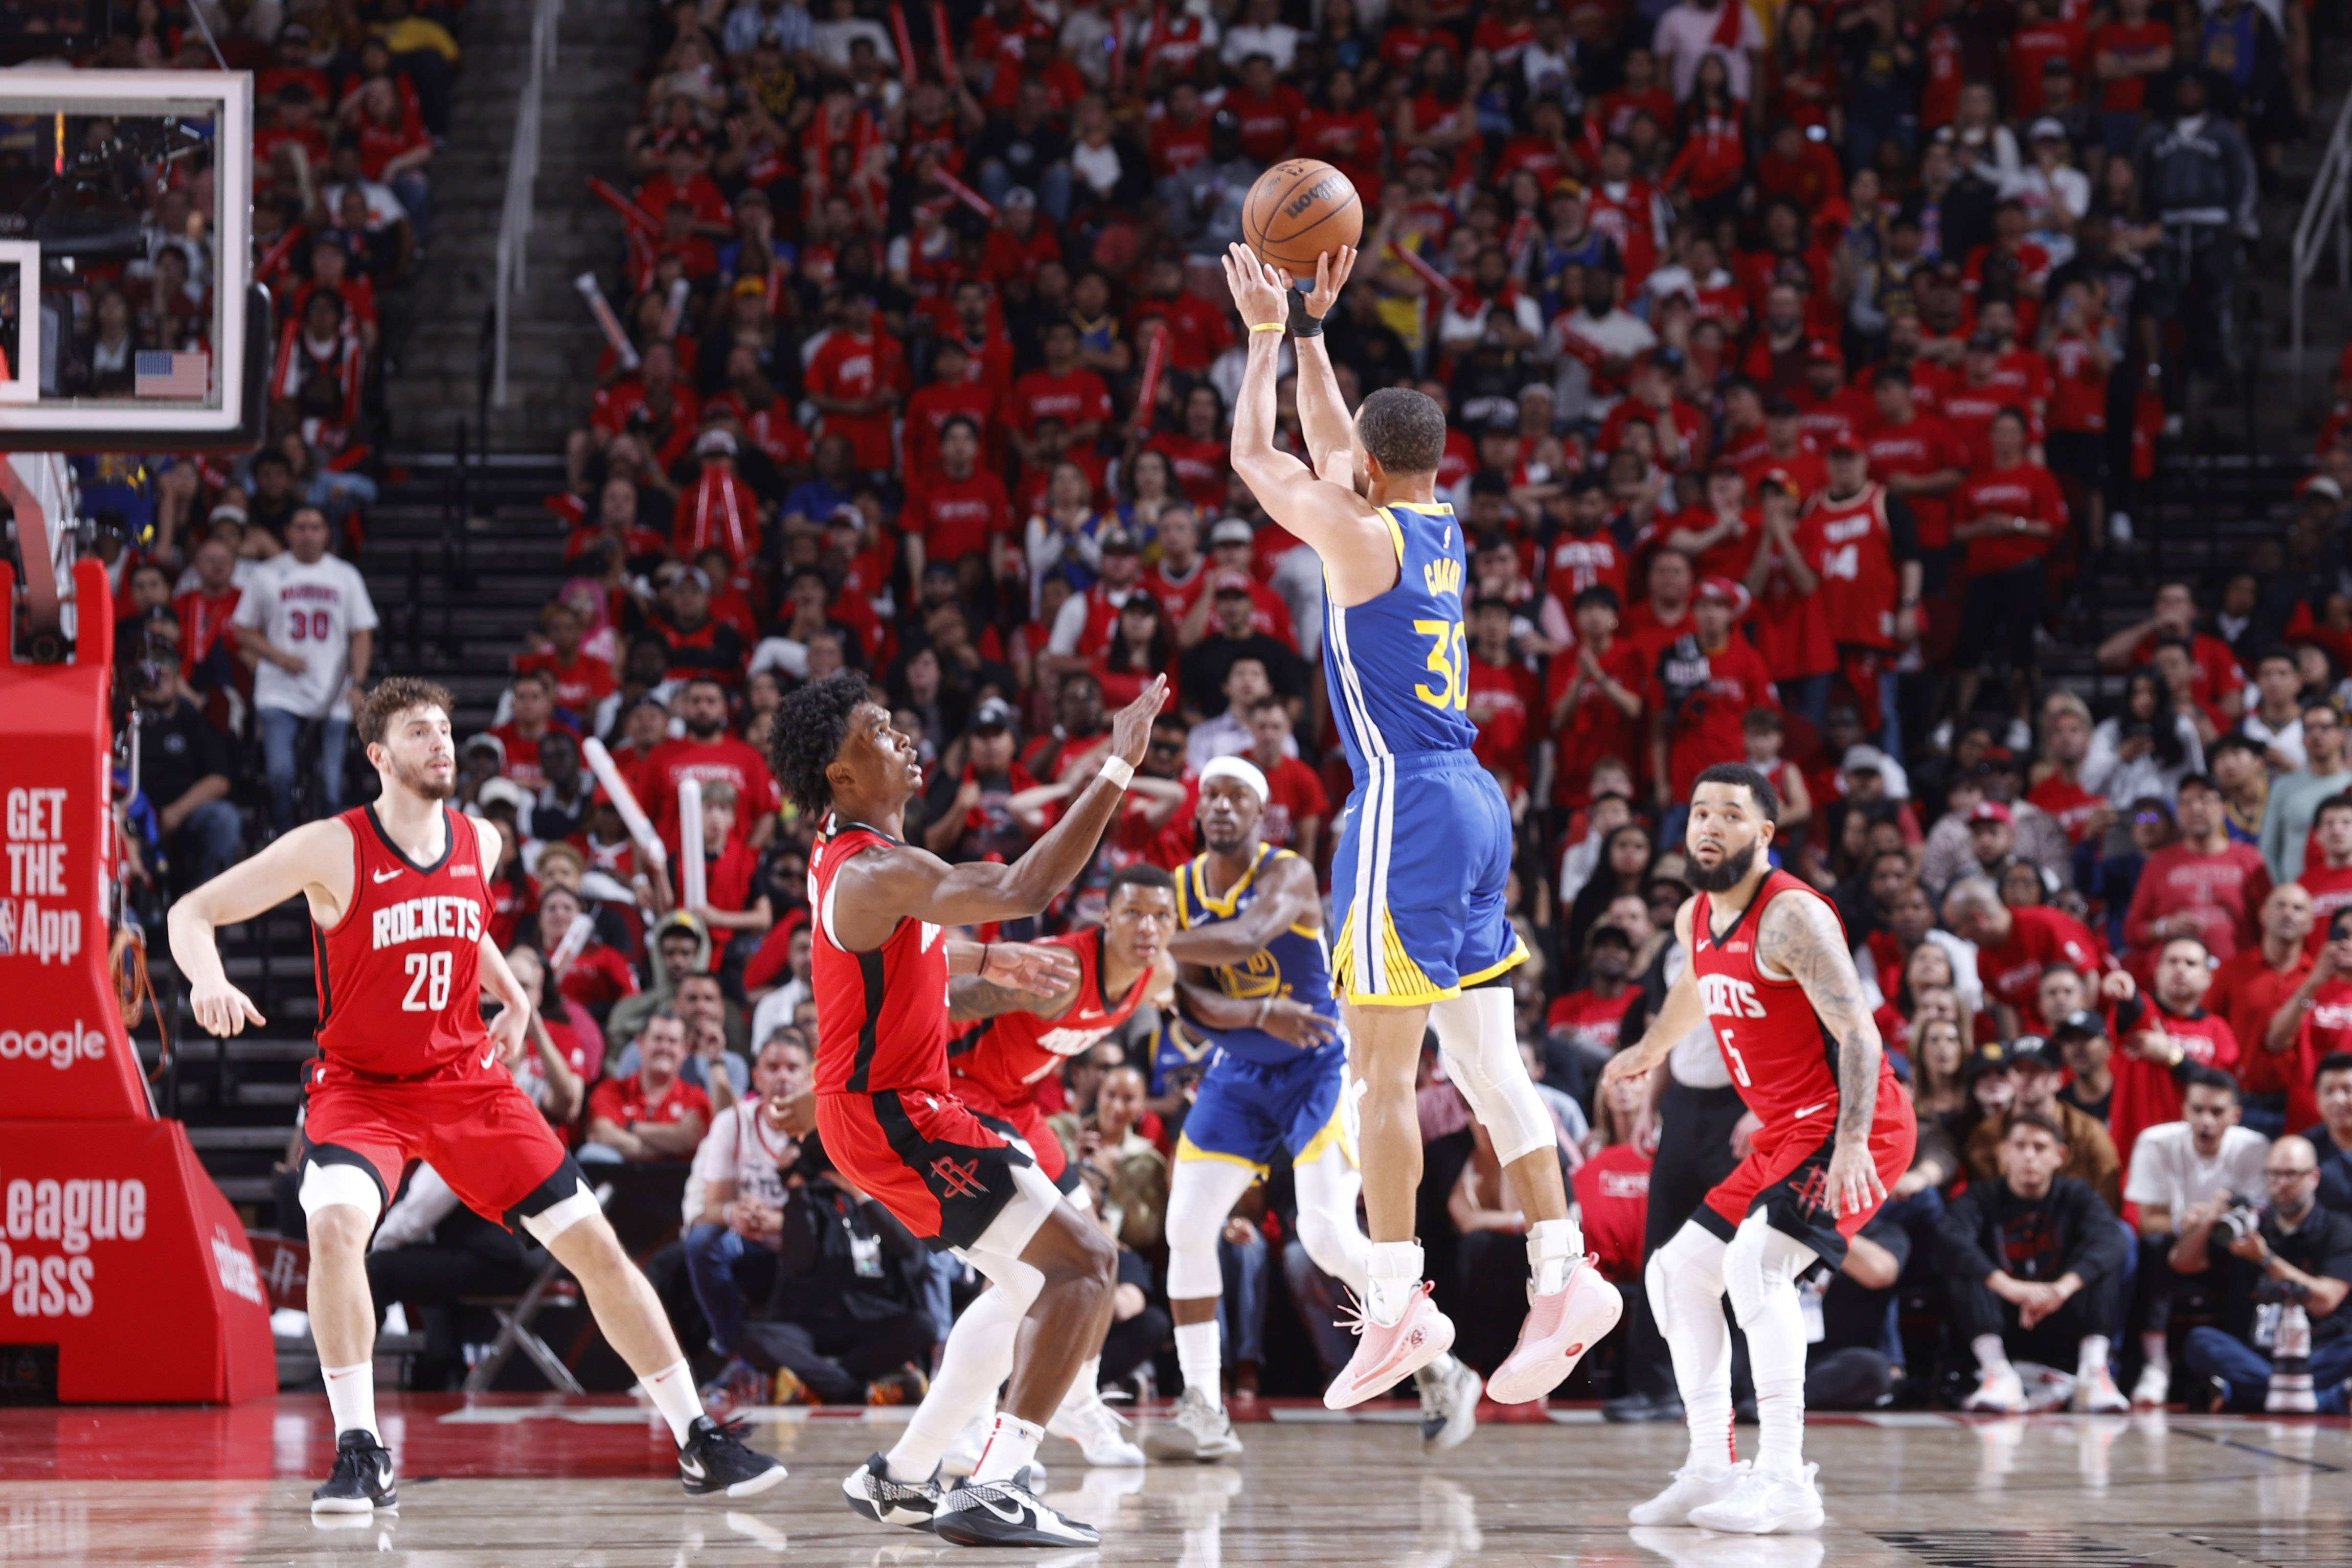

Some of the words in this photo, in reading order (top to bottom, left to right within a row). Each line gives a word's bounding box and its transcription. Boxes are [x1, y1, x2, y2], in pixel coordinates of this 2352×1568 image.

[1285, 174, 1351, 219] Wilson
[290, 609, 328, 641] 30
[1413, 619, 1469, 712] 30
[7, 788, 68, 841] GET
[5, 842, 68, 896] THE
[19, 898, 81, 964] App
[373, 895, 481, 950] ROCKETS
[402, 951, 453, 1011] 28
[1720, 1029, 1752, 1087] 5
[0, 1169, 146, 1255] eague
